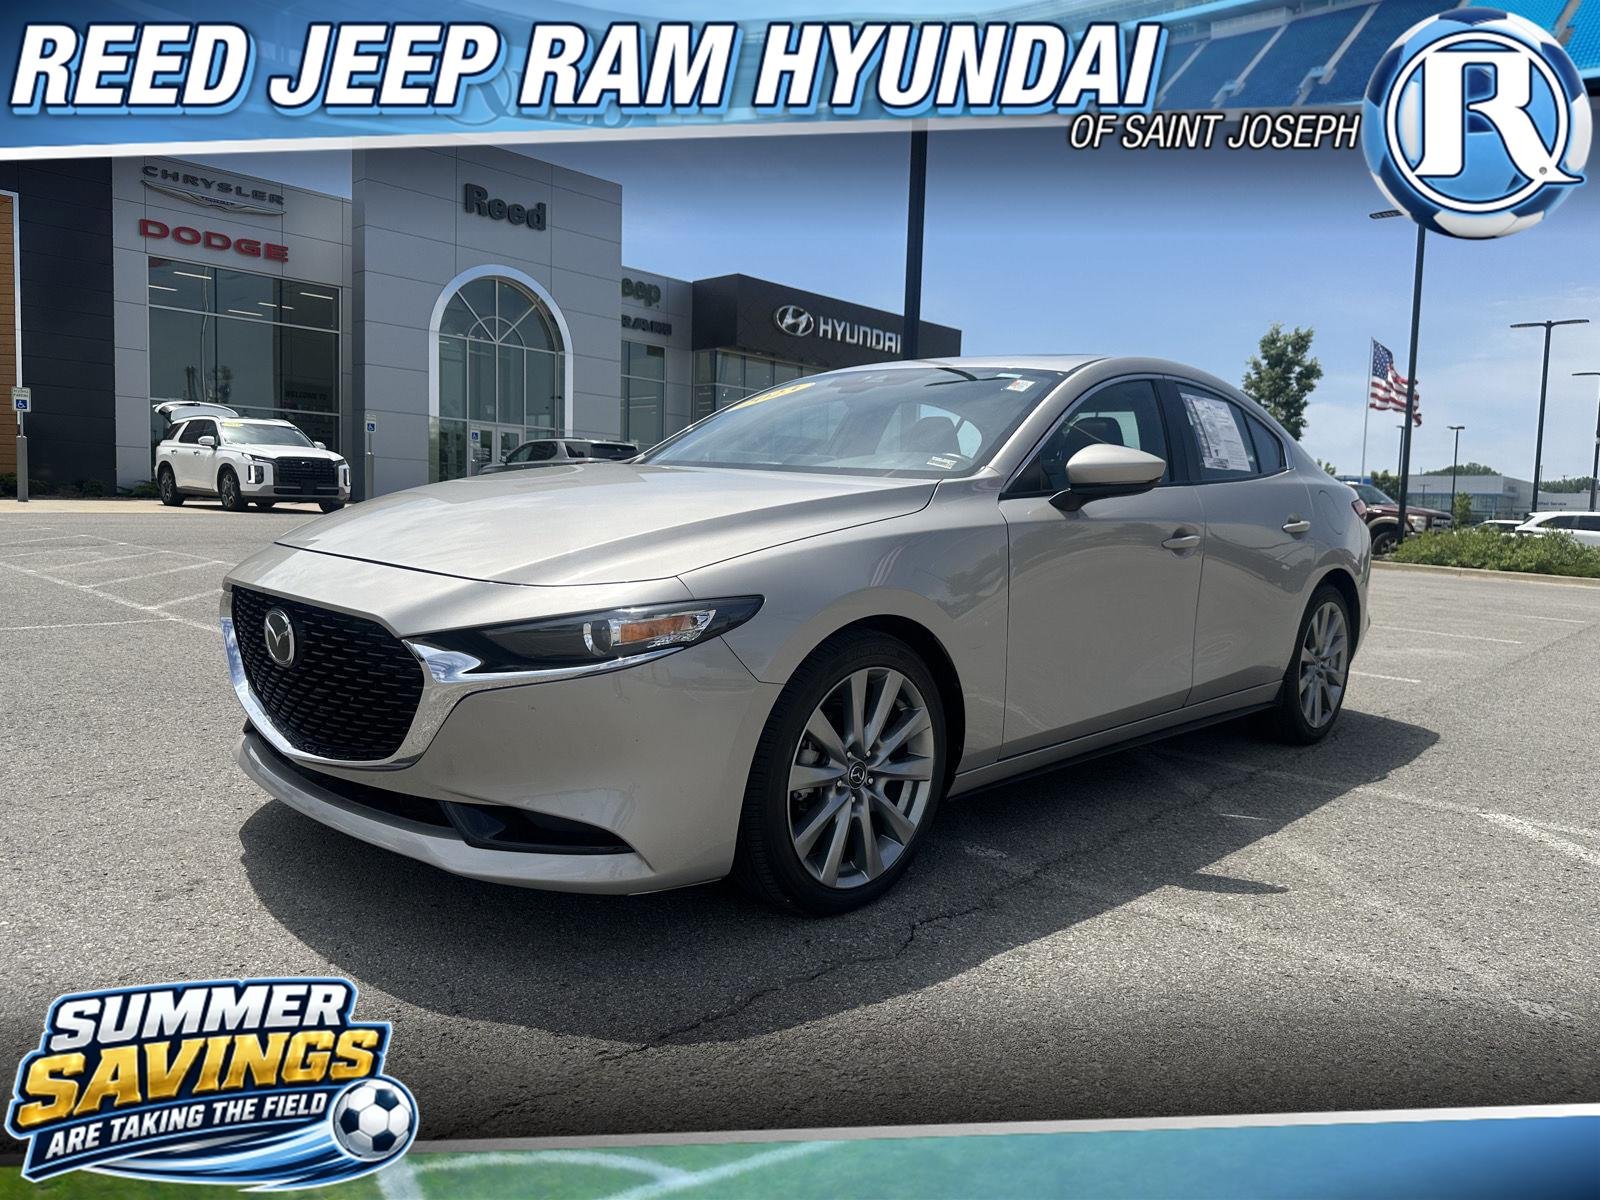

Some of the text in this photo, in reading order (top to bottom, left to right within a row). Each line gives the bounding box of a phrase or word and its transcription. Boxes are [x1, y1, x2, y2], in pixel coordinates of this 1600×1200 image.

[142, 165, 285, 206] CHRYSLER
[464, 182, 547, 231] Reed
[138, 218, 289, 263] DODGE
[621, 277, 661, 307] eep
[819, 315, 901, 354] HYUNDAI
